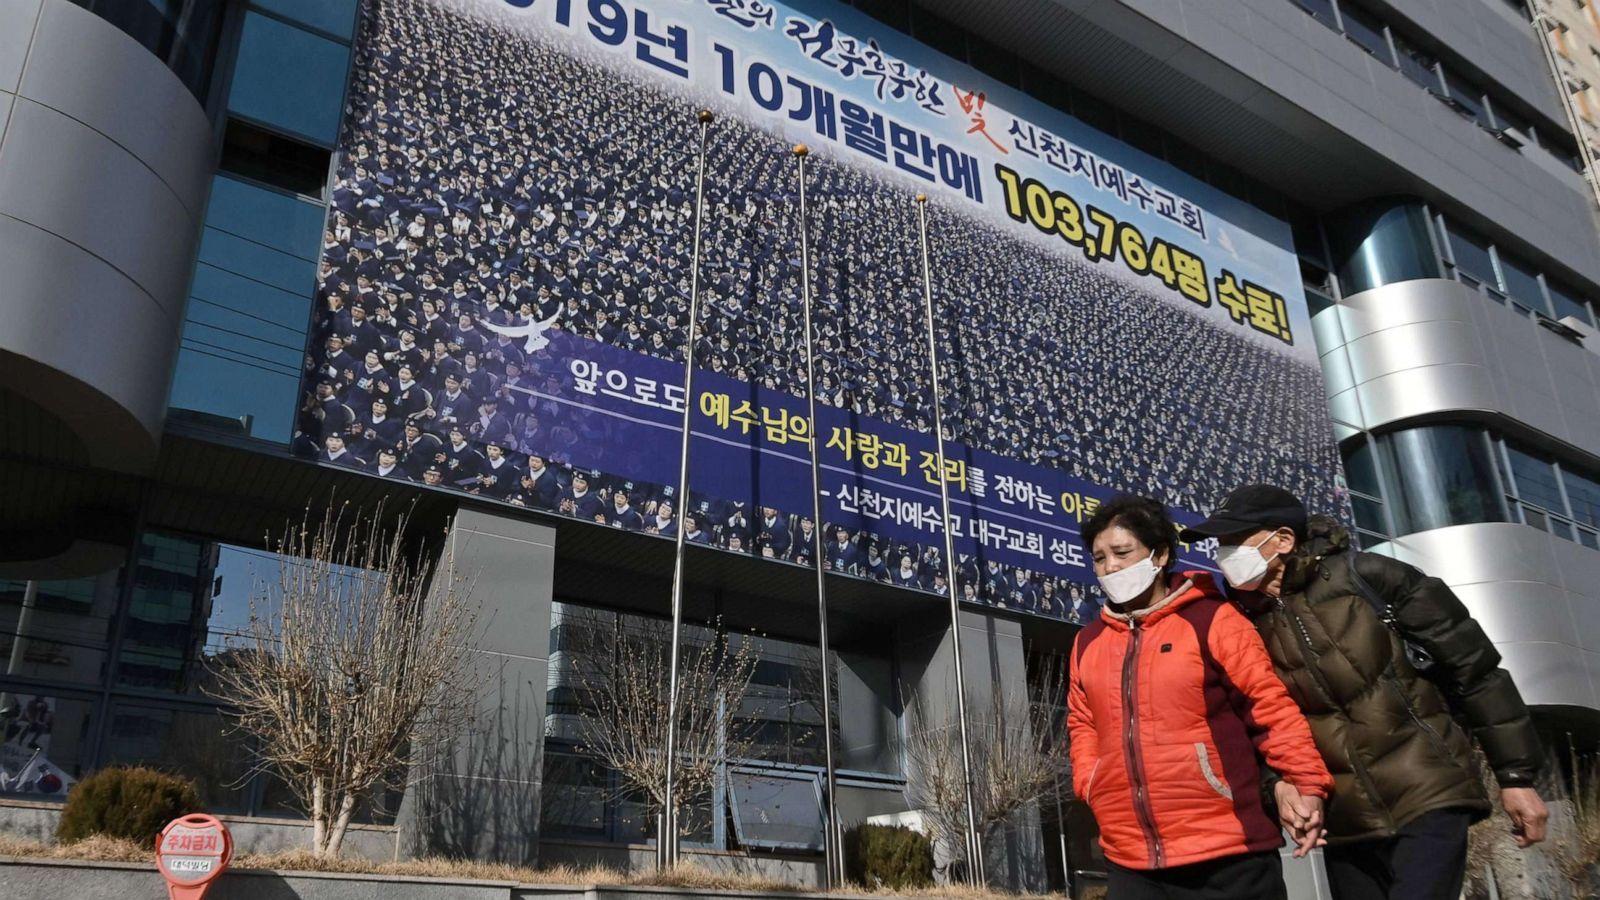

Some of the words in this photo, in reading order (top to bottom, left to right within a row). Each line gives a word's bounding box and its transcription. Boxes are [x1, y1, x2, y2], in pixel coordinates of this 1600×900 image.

[714, 42, 984, 204] 10개월만에
[996, 164, 1211, 308] 103,764명
[1215, 268, 1294, 346] 수료!
[952, 84, 1008, 154] 빛
[1008, 118, 1209, 240] 신천지예수교회
[570, 358, 686, 413] 앞으로도
[699, 391, 813, 452] 예수님의
[825, 427, 911, 476] 사랑과
[919, 451, 988, 498] 진리를
[994, 475, 1055, 516] 전하는
[836, 484, 964, 537] 신천지예수교
[969, 518, 1044, 560] 대구교회
[1049, 538, 1086, 568] 성도
[168, 834, 217, 851] 주차금지
